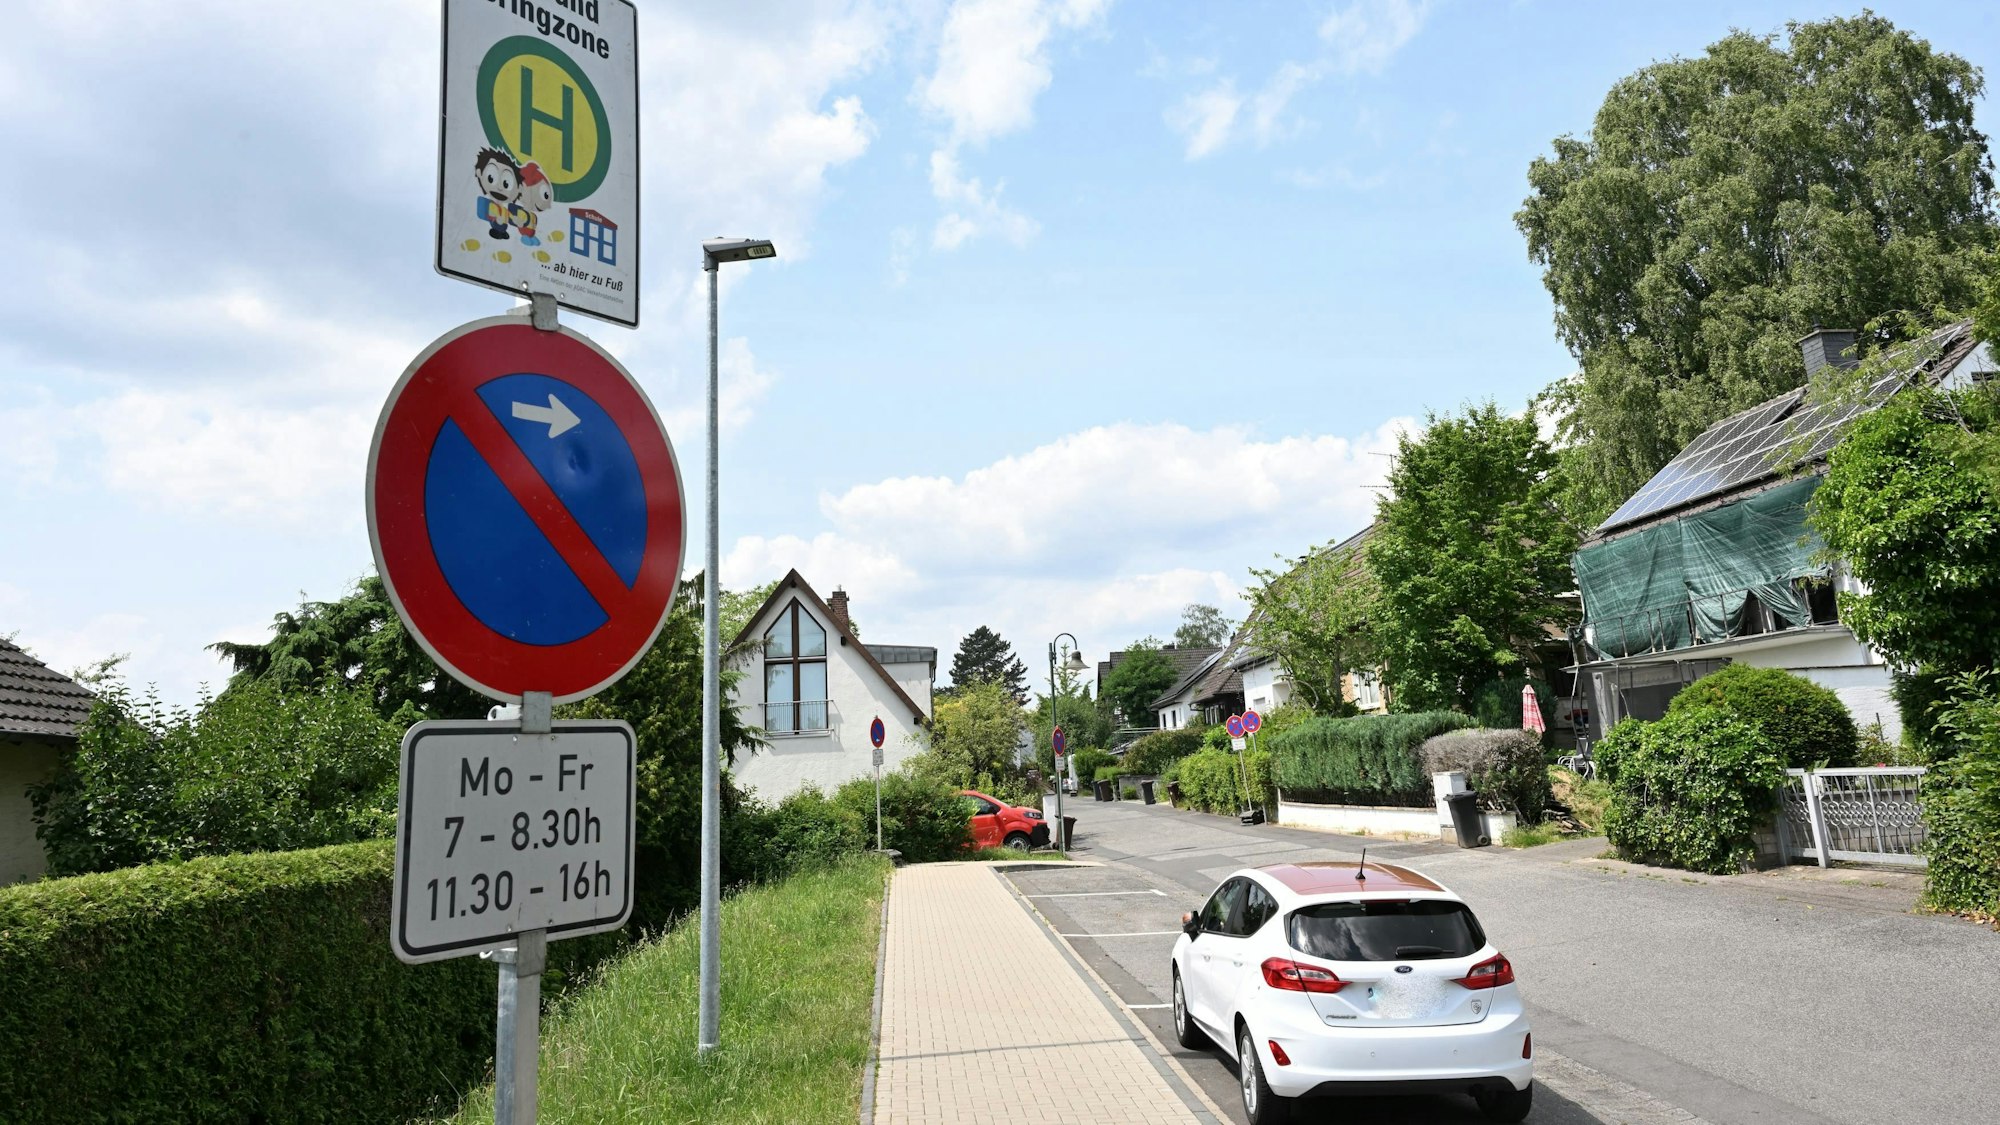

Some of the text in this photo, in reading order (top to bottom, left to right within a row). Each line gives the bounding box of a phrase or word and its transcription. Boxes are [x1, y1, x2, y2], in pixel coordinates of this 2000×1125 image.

[520, 64, 574, 173] H
[553, 262, 567, 274] ab
[569, 265, 590, 281] hier
[591, 275, 603, 286] zu
[605, 277, 623, 292] Fuß
[460, 757, 513, 797] Mo
[559, 754, 594, 791] Fr
[444, 807, 601, 858] 7 - 8.30h
[427, 860, 610, 921] 11.30 - 16h
